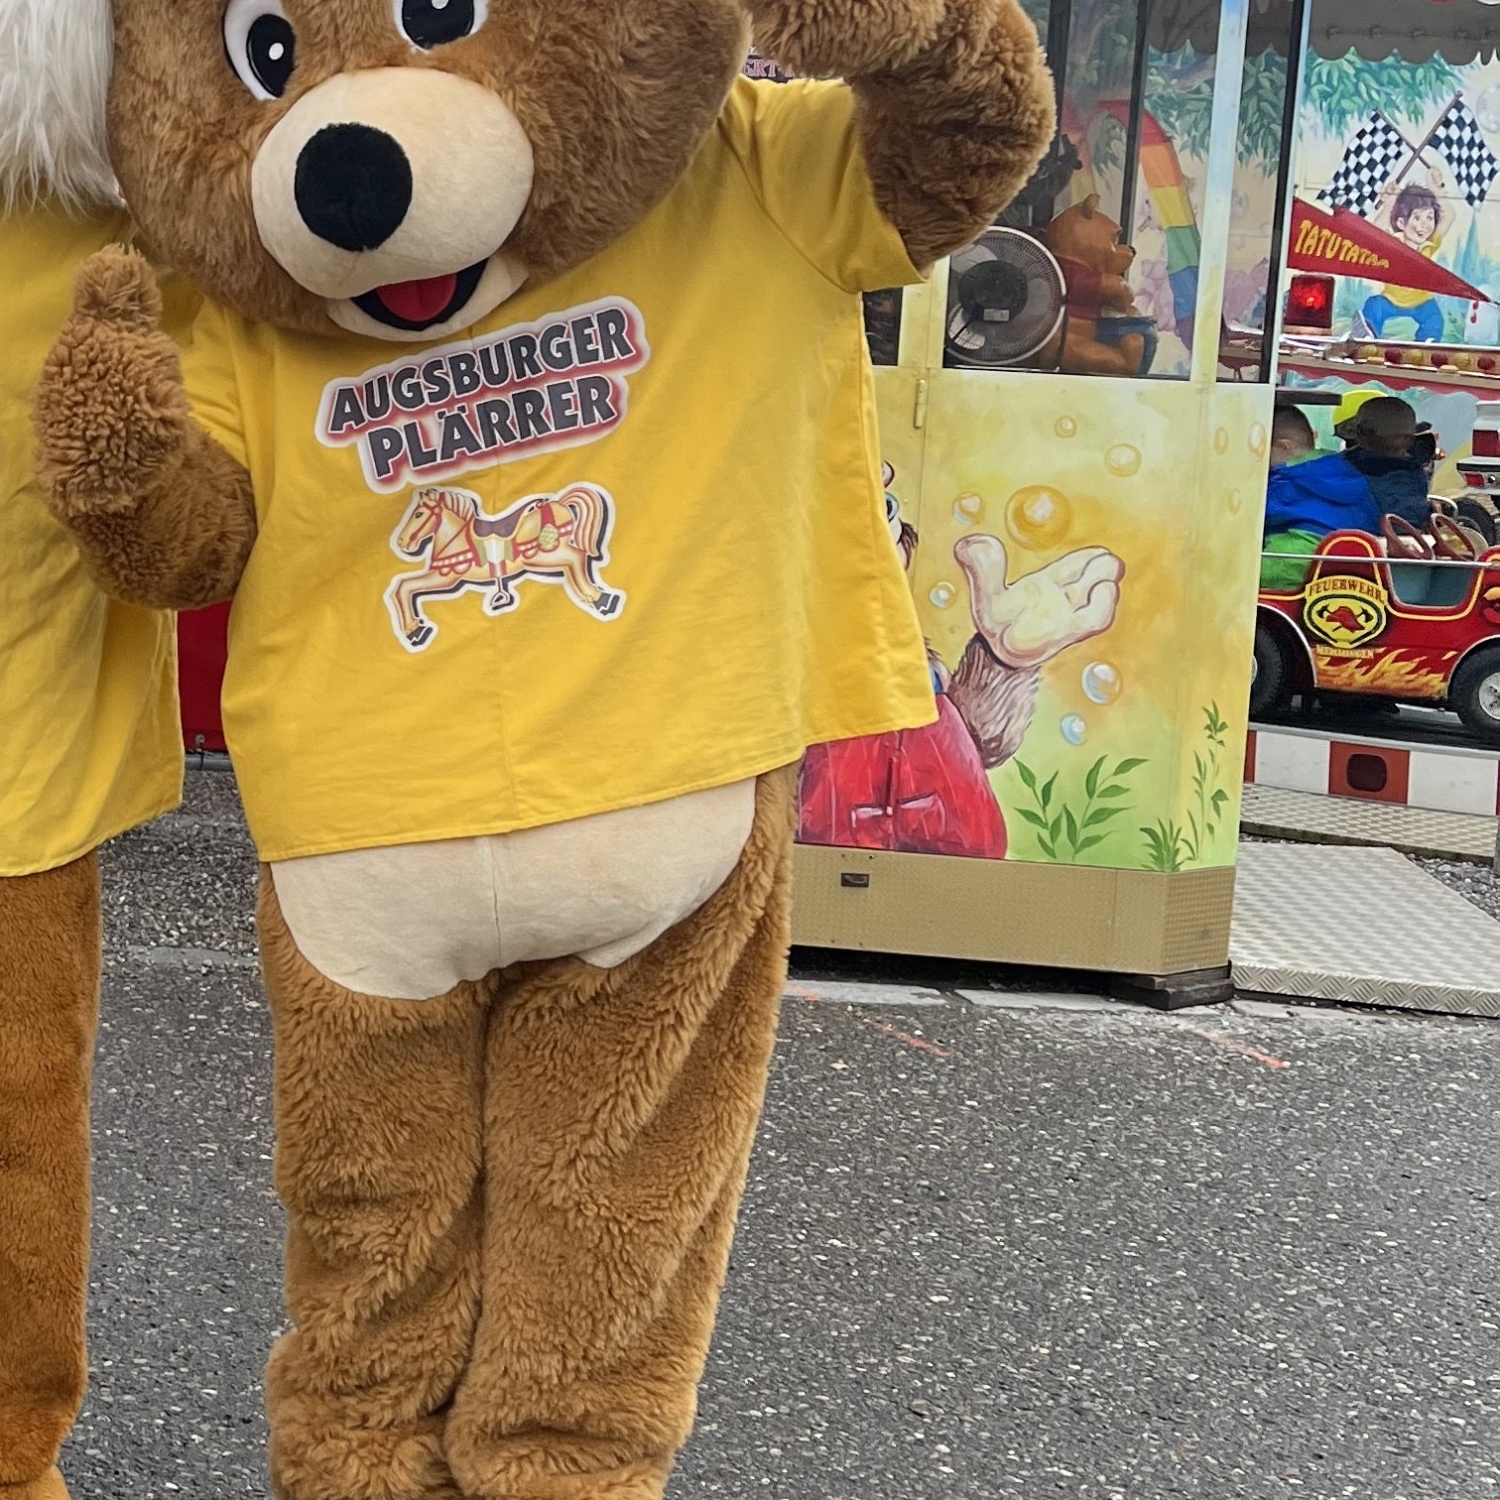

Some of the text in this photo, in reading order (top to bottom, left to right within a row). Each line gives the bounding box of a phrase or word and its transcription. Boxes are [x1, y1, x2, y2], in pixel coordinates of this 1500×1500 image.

[329, 307, 635, 433] AUGSBURGER
[367, 373, 618, 480] PLÄRRER
[1309, 578, 1385, 604] FEUERWEHR
